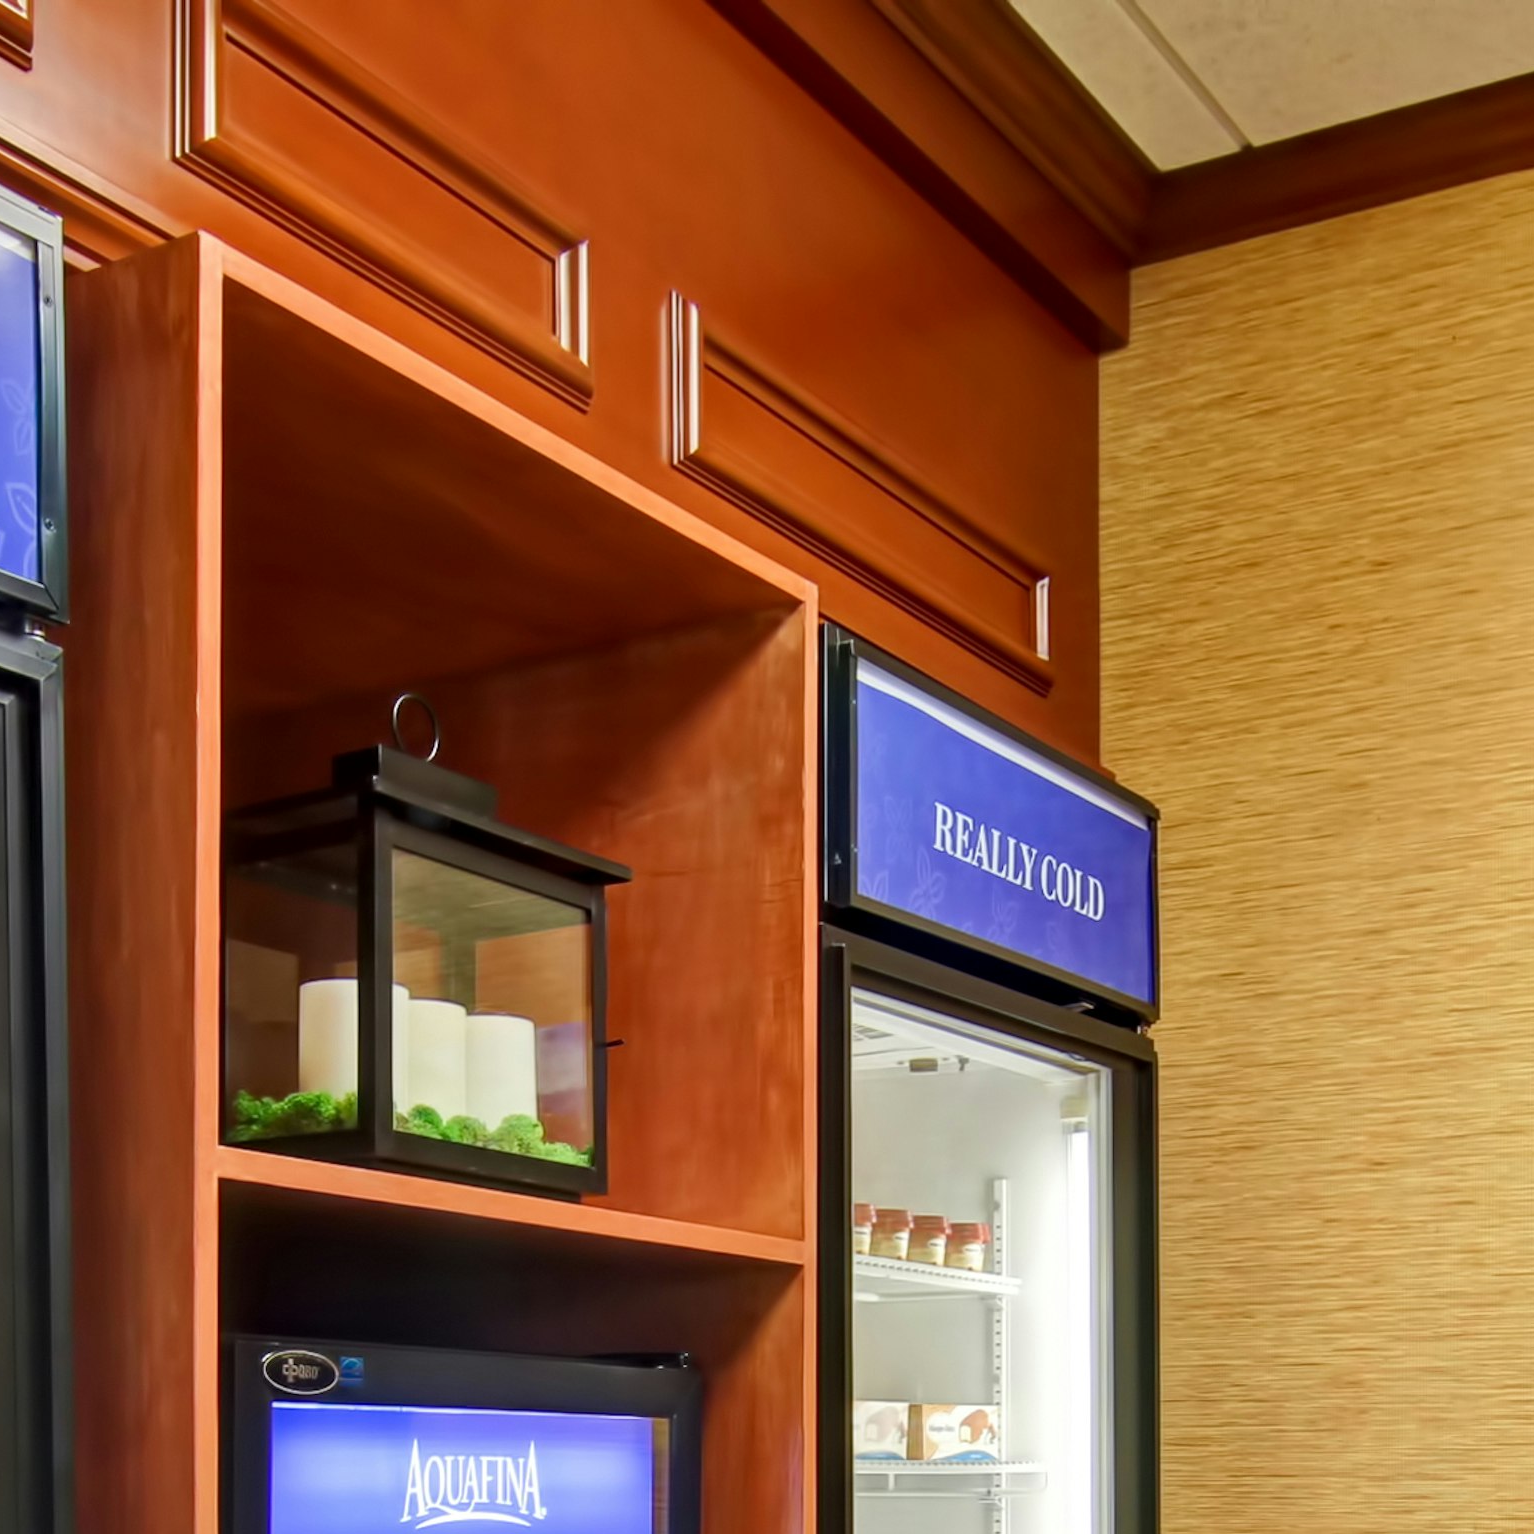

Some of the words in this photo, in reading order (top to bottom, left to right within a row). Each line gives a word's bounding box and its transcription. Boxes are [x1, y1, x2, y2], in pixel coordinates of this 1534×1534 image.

[933, 802, 1038, 891] REALLY
[1040, 855, 1106, 922] COLD
[400, 1439, 544, 1524] AQUAFINA
